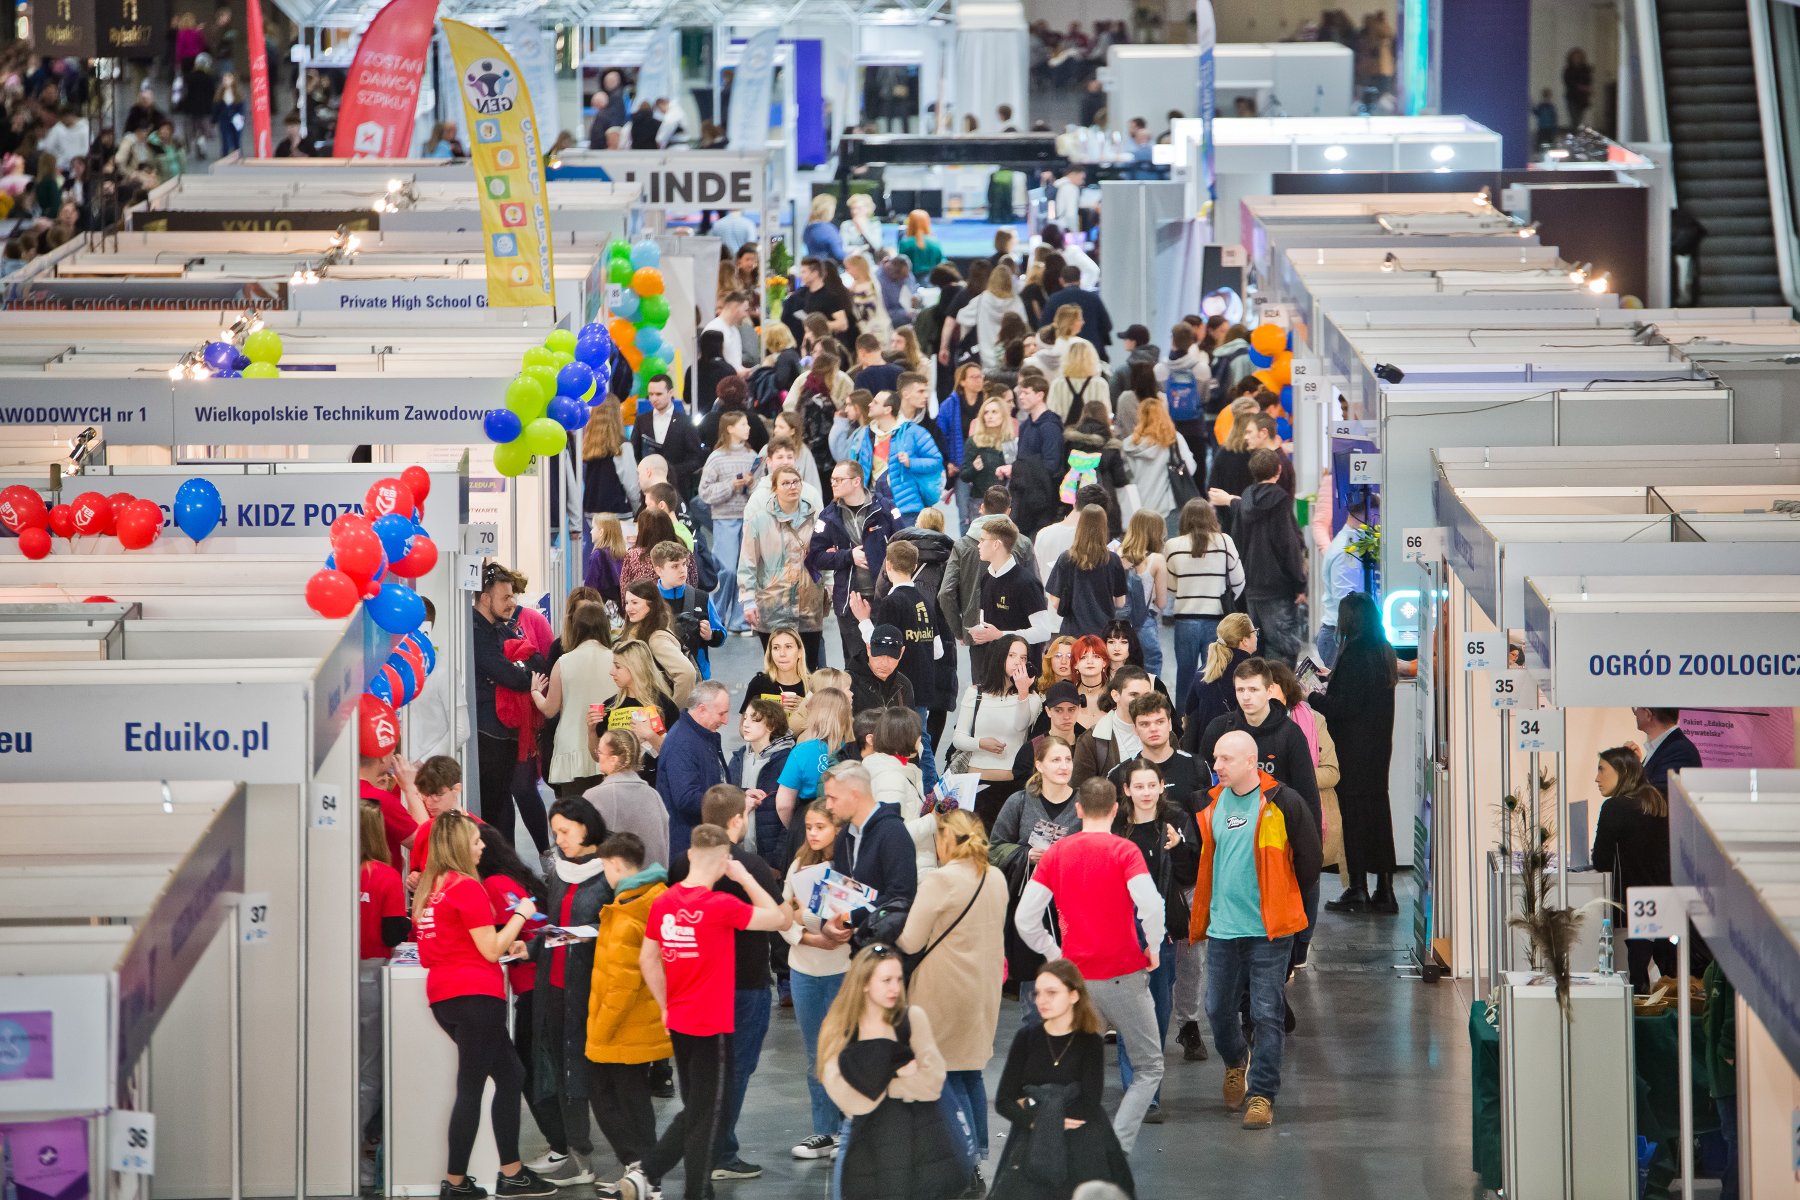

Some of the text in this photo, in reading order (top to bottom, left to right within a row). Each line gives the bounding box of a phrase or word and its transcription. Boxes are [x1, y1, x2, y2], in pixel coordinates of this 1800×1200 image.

[359, 70, 416, 95] DAWCĄ
[340, 294, 387, 308] Private
[392, 295, 421, 311] High
[426, 294, 472, 308] School
[1295, 366, 1306, 375] 82
[1304, 383, 1317, 392] 69
[117, 411, 133, 422] nr
[139, 407, 146, 421] 1
[195, 406, 308, 425] Wielkopolskie
[314, 405, 399, 421] Technikum
[1354, 461, 1367, 471] 67
[237, 503, 296, 527] KIDZ
[480, 532, 494, 543] 70
[1406, 536, 1422, 547] 66
[469, 565, 478, 576] 71
[1467, 641, 1485, 655] 65
[1589, 649, 1672, 676] OGRÓD
[1495, 679, 1514, 693] 35
[1520, 720, 1540, 735] 34
[125, 721, 269, 758] Eduiko.pl
[322, 795, 336, 810] 64
[251, 905, 267, 923] 37
[1634, 900, 1657, 917] 33
[128, 1127, 148, 1149] 36
